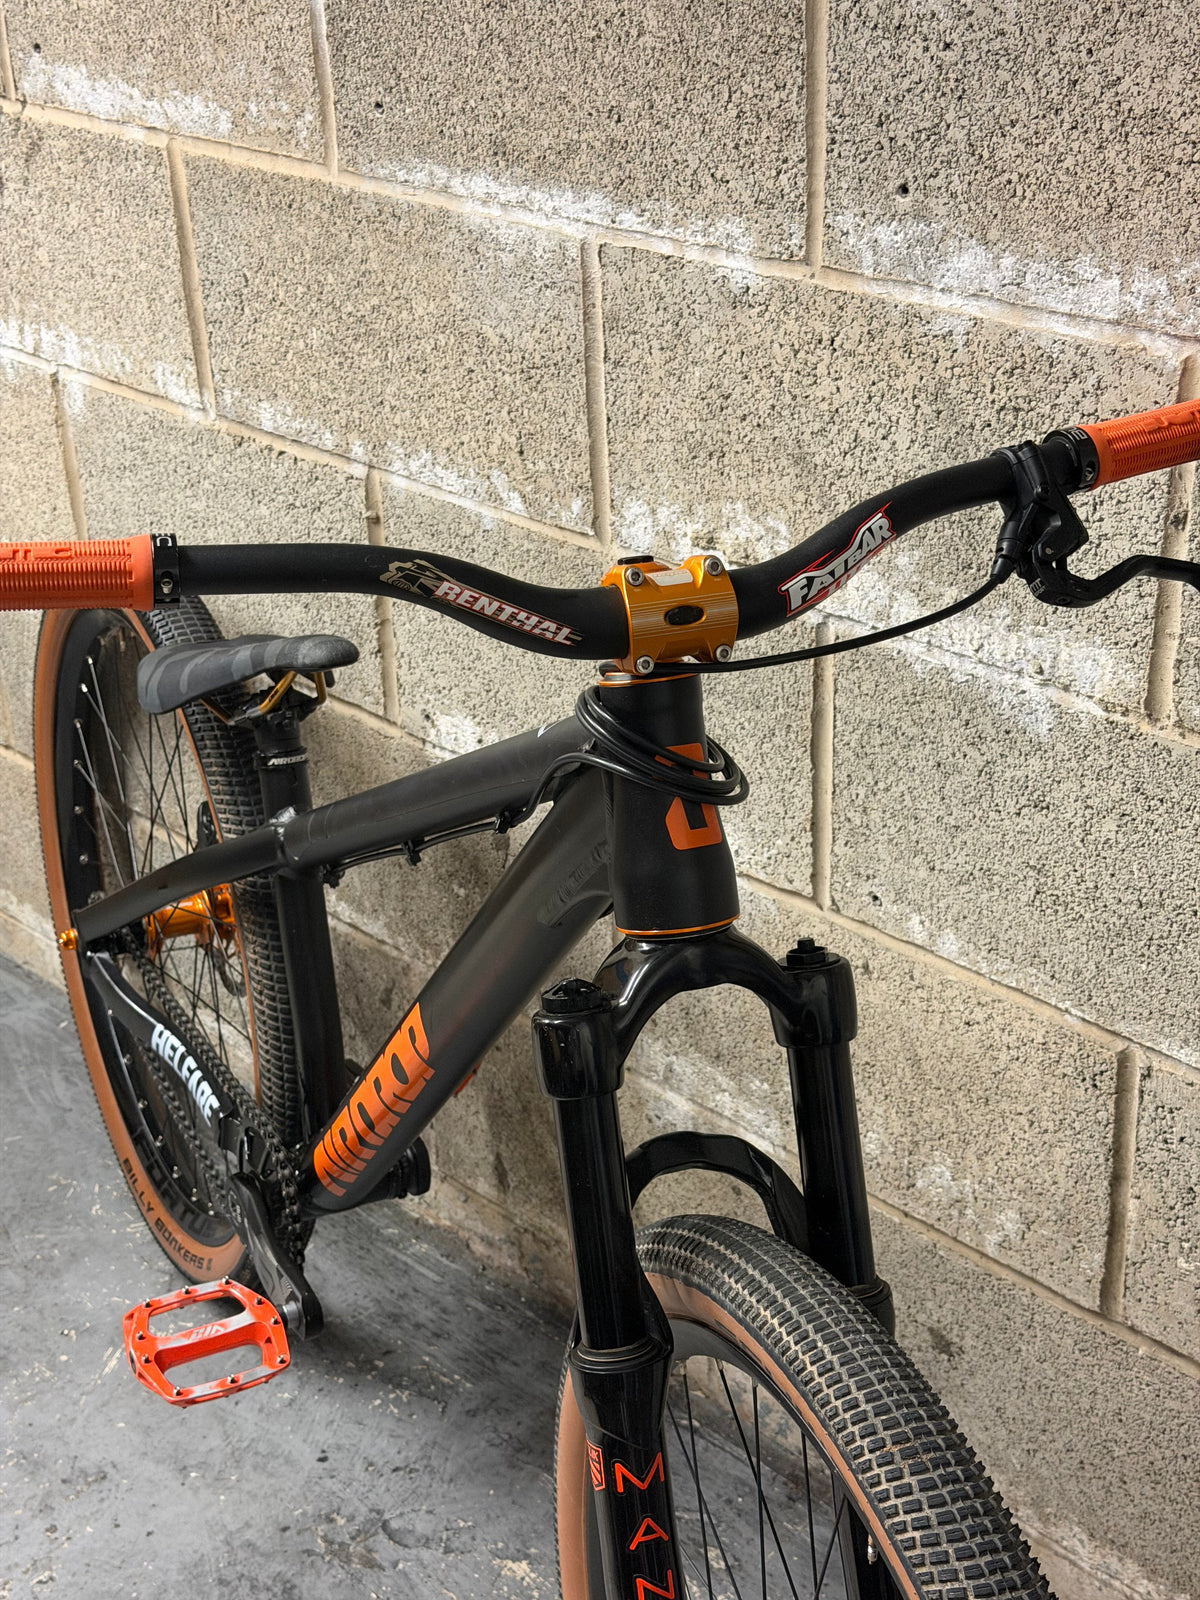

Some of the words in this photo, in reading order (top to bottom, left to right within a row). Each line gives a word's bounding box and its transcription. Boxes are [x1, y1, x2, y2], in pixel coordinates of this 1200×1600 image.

[780, 511, 893, 611] FATBAR
[433, 579, 574, 646] RENTHAL
[122, 1157, 154, 1213] BILLY
[154, 1217, 205, 1270] BONKERS
